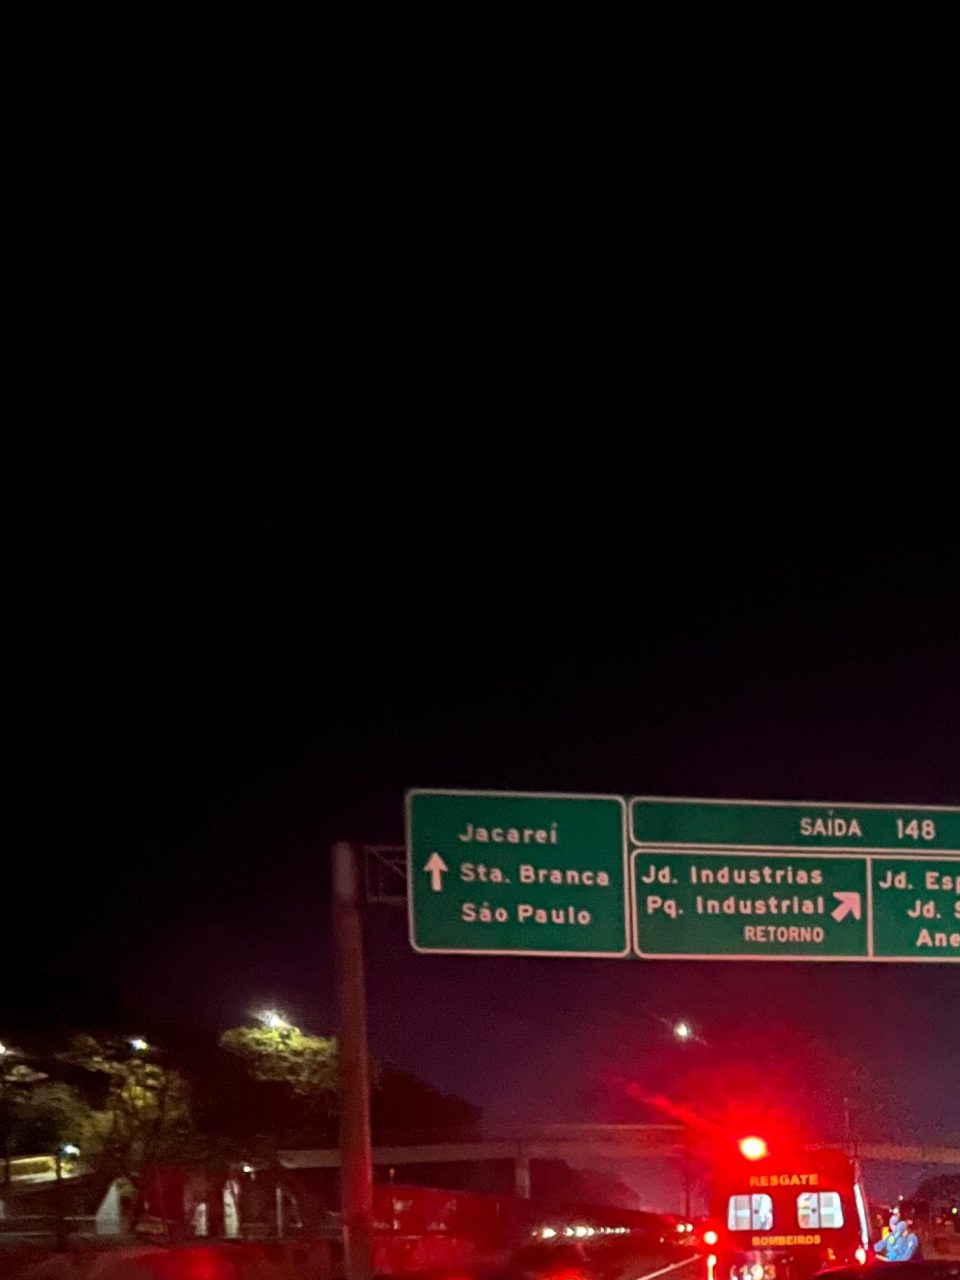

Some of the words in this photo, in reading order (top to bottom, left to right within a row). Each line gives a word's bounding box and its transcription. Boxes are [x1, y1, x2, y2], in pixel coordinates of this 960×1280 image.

[458, 821, 559, 845] Jacareí
[799, 809, 862, 837] SAÍDA
[896, 818, 936, 841] 148
[460, 862, 511, 884] Sta.
[519, 864, 610, 887] Branca
[641, 864, 678, 885] Jd.
[878, 870, 913, 890] Jd.
[461, 902, 509, 923] São
[517, 904, 592, 926] Paulo
[646, 895, 684, 919] Pq.
[696, 895, 825, 915] Industrial
[907, 899, 942, 920] Jd.
[743, 926, 826, 944] RETORNO
[749, 1173, 819, 1187] RESGATE
[751, 1234, 822, 1247] BOMBEIROS
